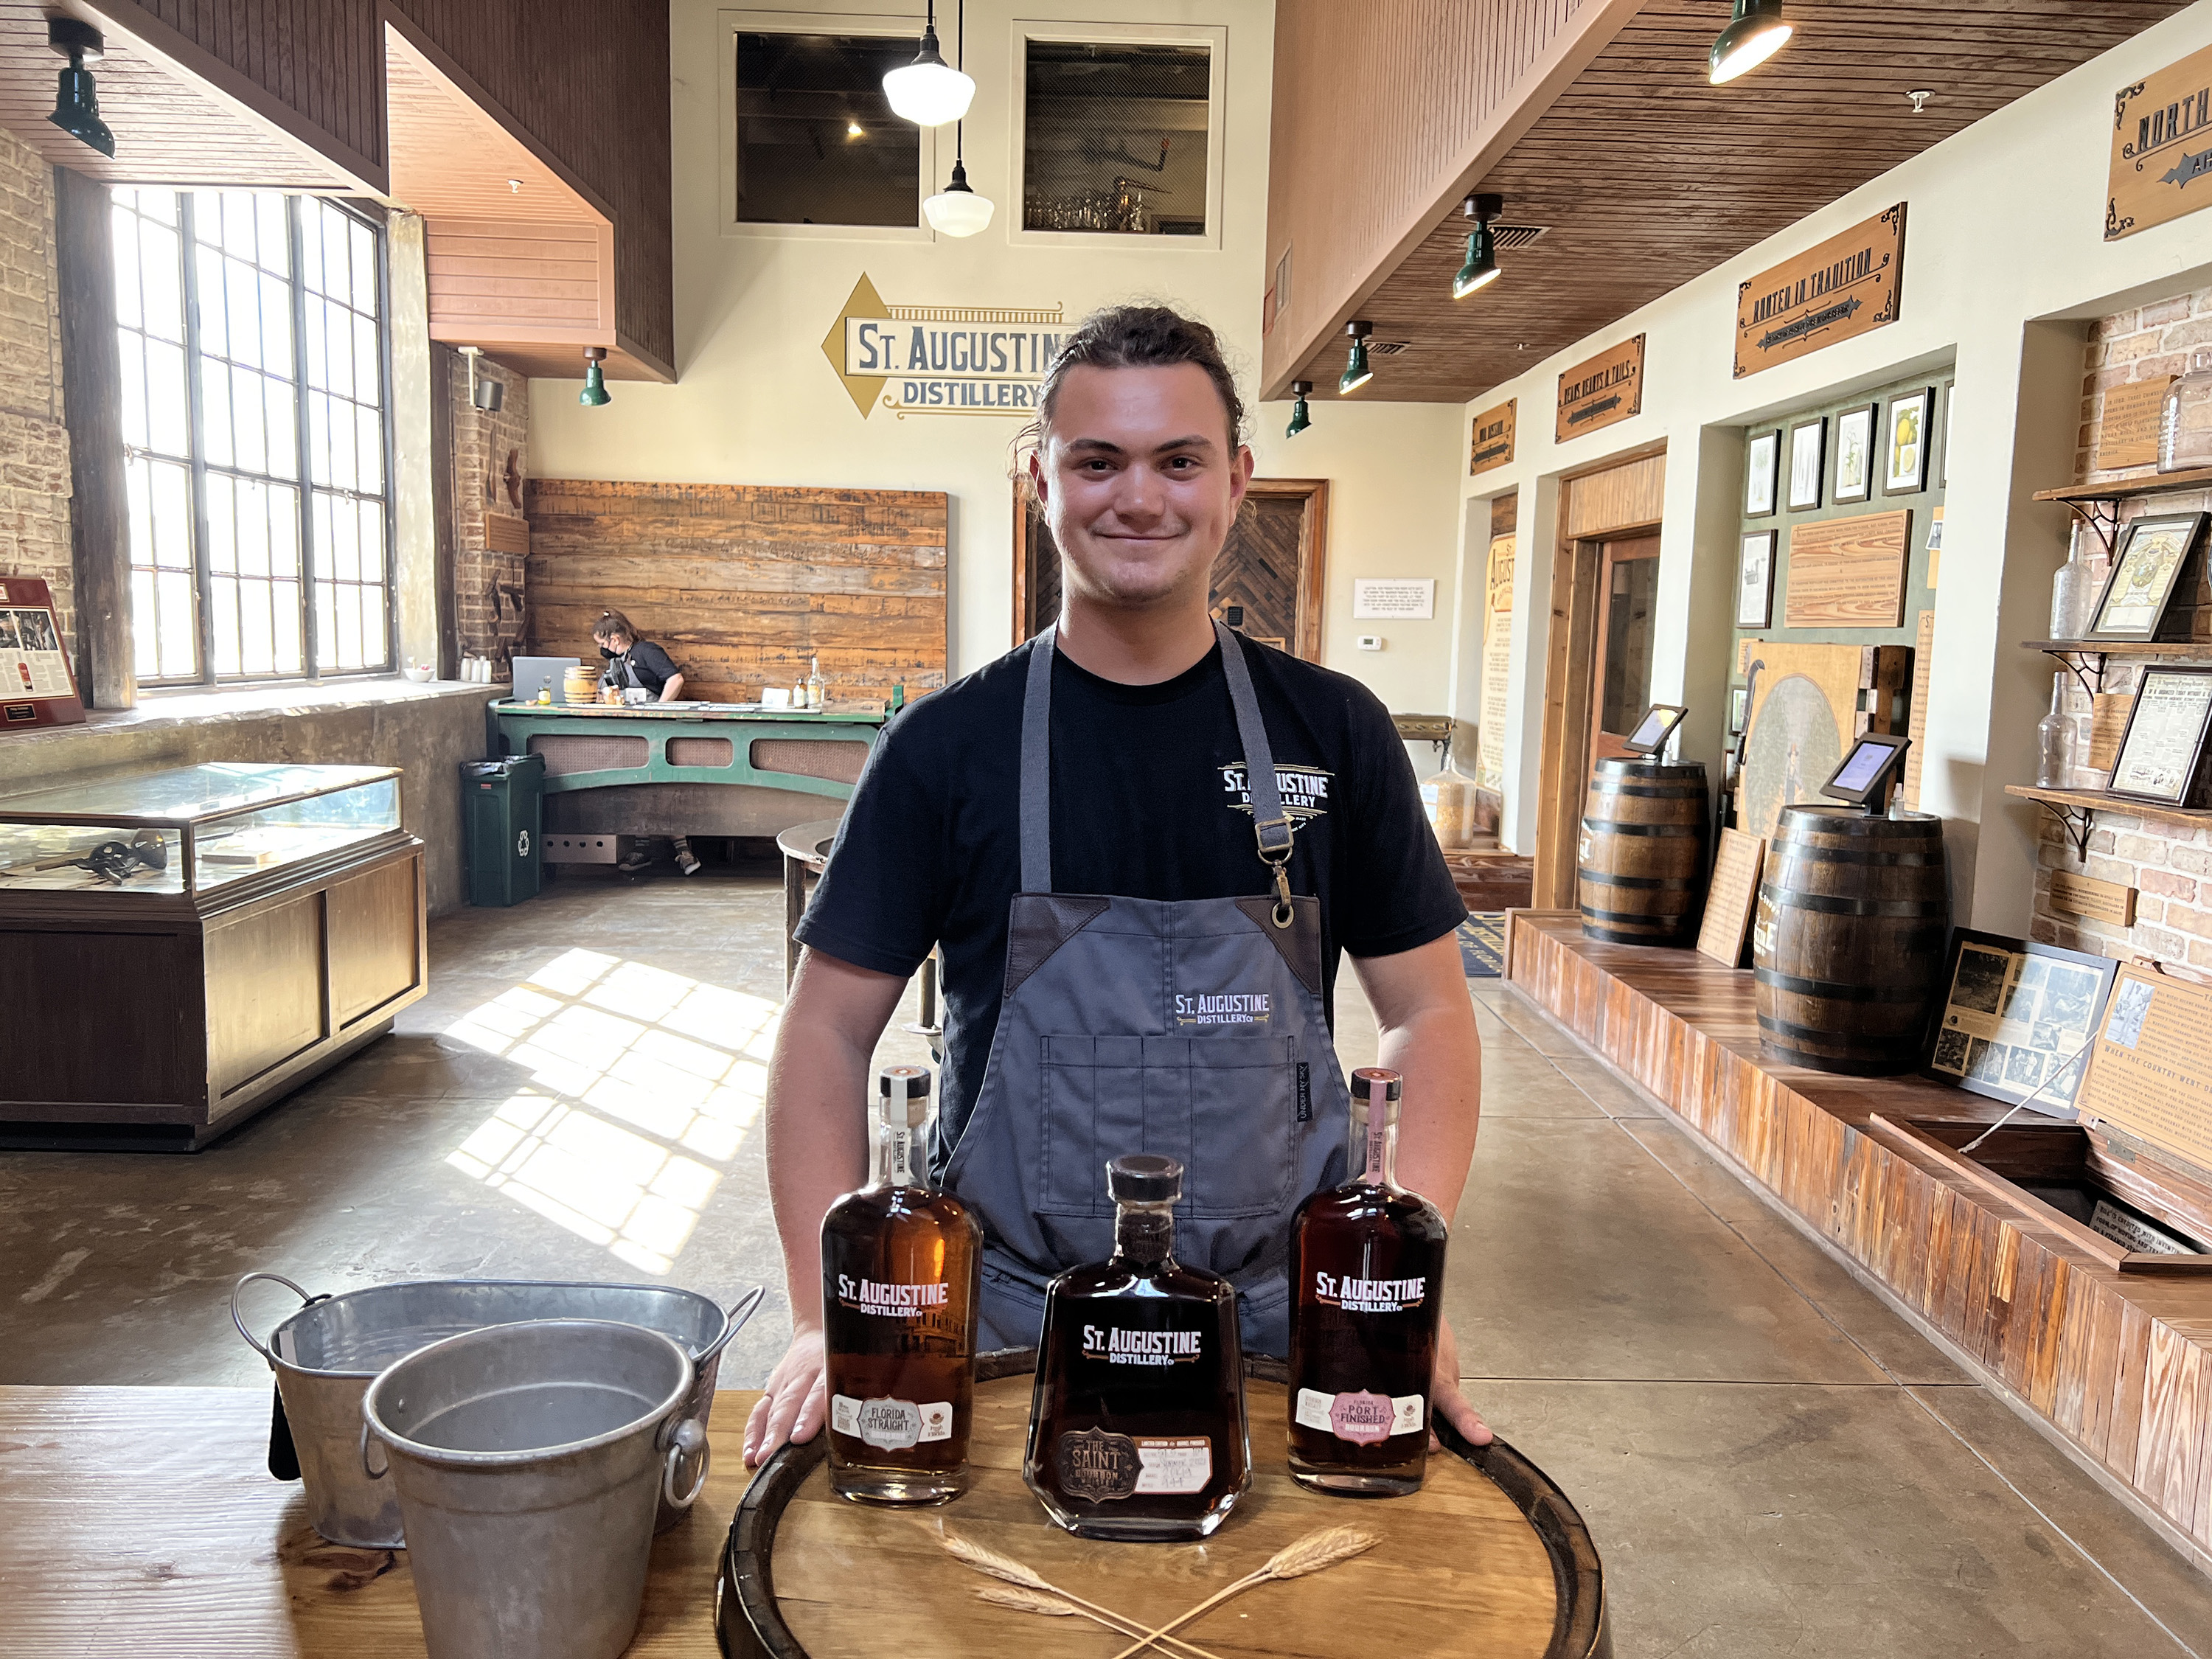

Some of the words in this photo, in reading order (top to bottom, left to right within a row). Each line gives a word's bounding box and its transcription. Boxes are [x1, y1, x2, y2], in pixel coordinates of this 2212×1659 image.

[2138, 87, 2210, 152] NORTH
[1753, 285, 1791, 323] ROOTED
[1795, 278, 1806, 305] IN
[1811, 247, 1871, 299] TRADITION
[907, 326, 1060, 373] AUGUSTIN
[1612, 360, 1630, 384] TAILS
[1197, 994, 1270, 1014] AUGUSTINE
[2104, 1045, 2124, 1058] WHEN
[2126, 1054, 2140, 1065] THE
[2143, 1060, 2177, 1079] COUNTRY
[2180, 1075, 2201, 1093] WENT
[897, 1141, 905, 1174] AUGUSTINE
[1372, 1140, 1382, 1173] AUGUSTINE
[859, 1279, 949, 1306] AUGUSTINE
[1340, 1276, 1425, 1301] AUGUSTINE
[860, 1303, 917, 1317] DISTILLERY
[1341, 1299, 1397, 1312] DISTILLERY
[1108, 1327, 1201, 1354] AUGUSTINE
[1110, 1352, 1169, 1366] DISTILLERY
[872, 1407, 905, 1420] FLORIDA
[1340, 1413, 1385, 1424] FINISHED
[1349, 1405, 1378, 1416] PORT
[868, 1419, 909, 1431] STRAIGHT
[1086, 1439, 1105, 1451] THE
[1072, 1448, 1121, 1470] SAINT
